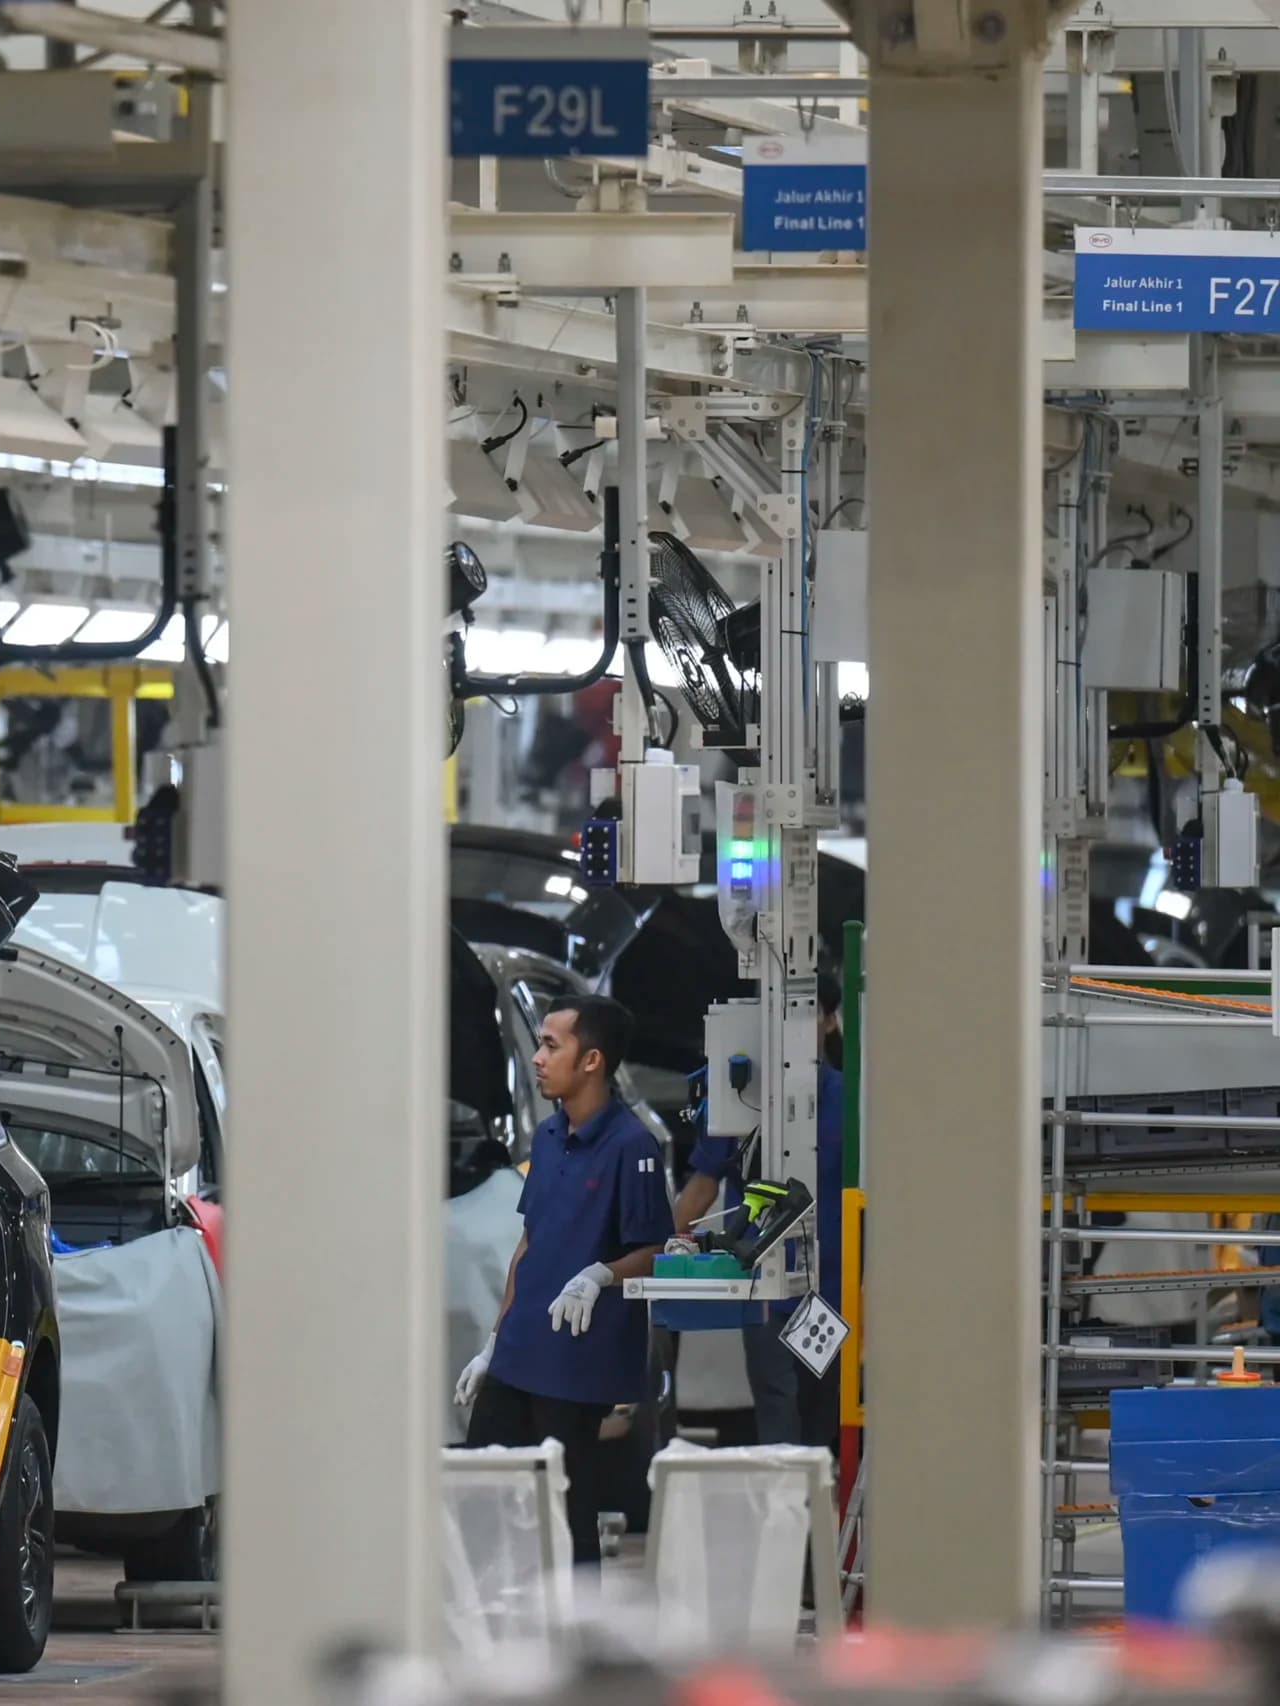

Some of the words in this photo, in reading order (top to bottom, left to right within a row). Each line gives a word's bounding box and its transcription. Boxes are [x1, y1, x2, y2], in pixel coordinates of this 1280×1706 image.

[493, 84, 619, 137] F29L
[774, 190, 812, 204] Jalur
[814, 190, 854, 204] Akhir
[857, 190, 864, 204] 1
[774, 215, 815, 230] Final
[817, 215, 854, 230] Line
[857, 215, 864, 230] 1
[1103, 277, 1137, 289] Jalur
[1138, 277, 1173, 290] Akhir
[1176, 278, 1184, 290] 1
[1208, 277, 1280, 316] F27
[1102, 299, 1138, 312] Final
[1141, 300, 1173, 313] Line
[1176, 301, 1184, 313] 1
